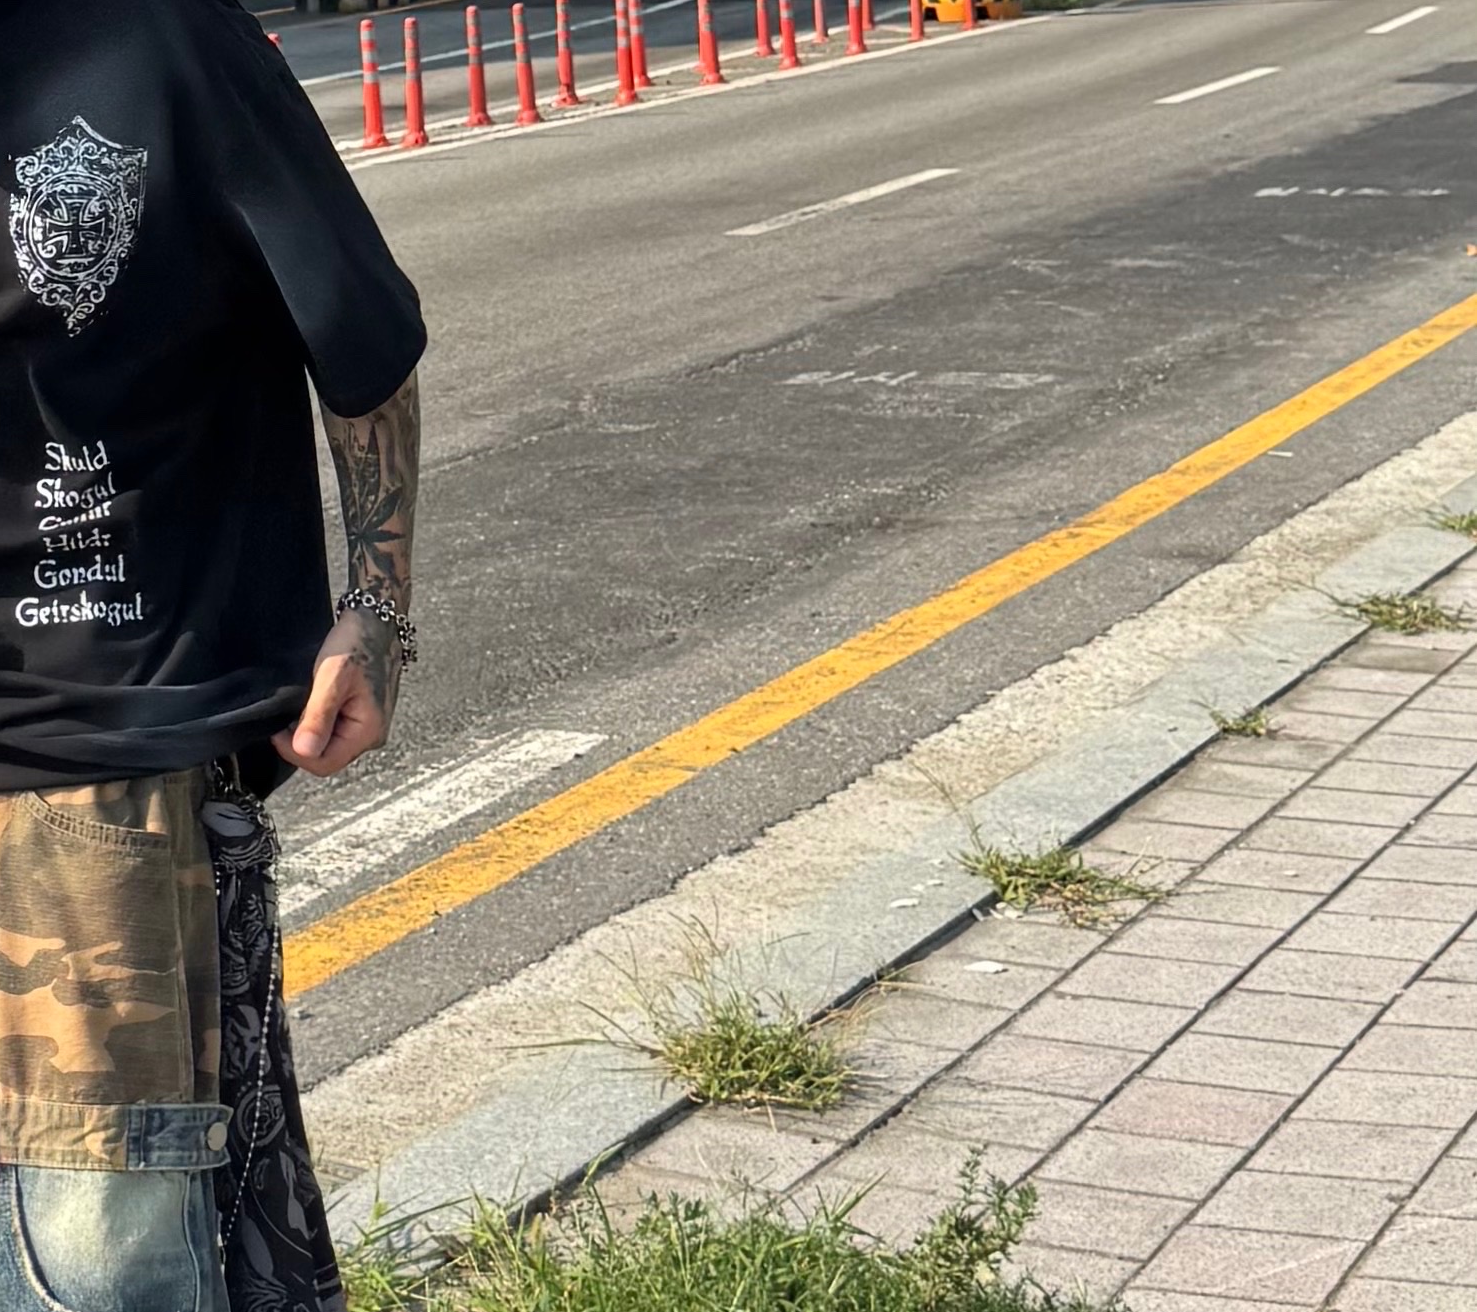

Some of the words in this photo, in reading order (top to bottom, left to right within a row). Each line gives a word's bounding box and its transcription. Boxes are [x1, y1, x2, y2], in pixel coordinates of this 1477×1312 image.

[34, 471, 117, 510] Skogul
[33, 553, 126, 589] Gondul
[15, 589, 144, 627] Geirskogul
